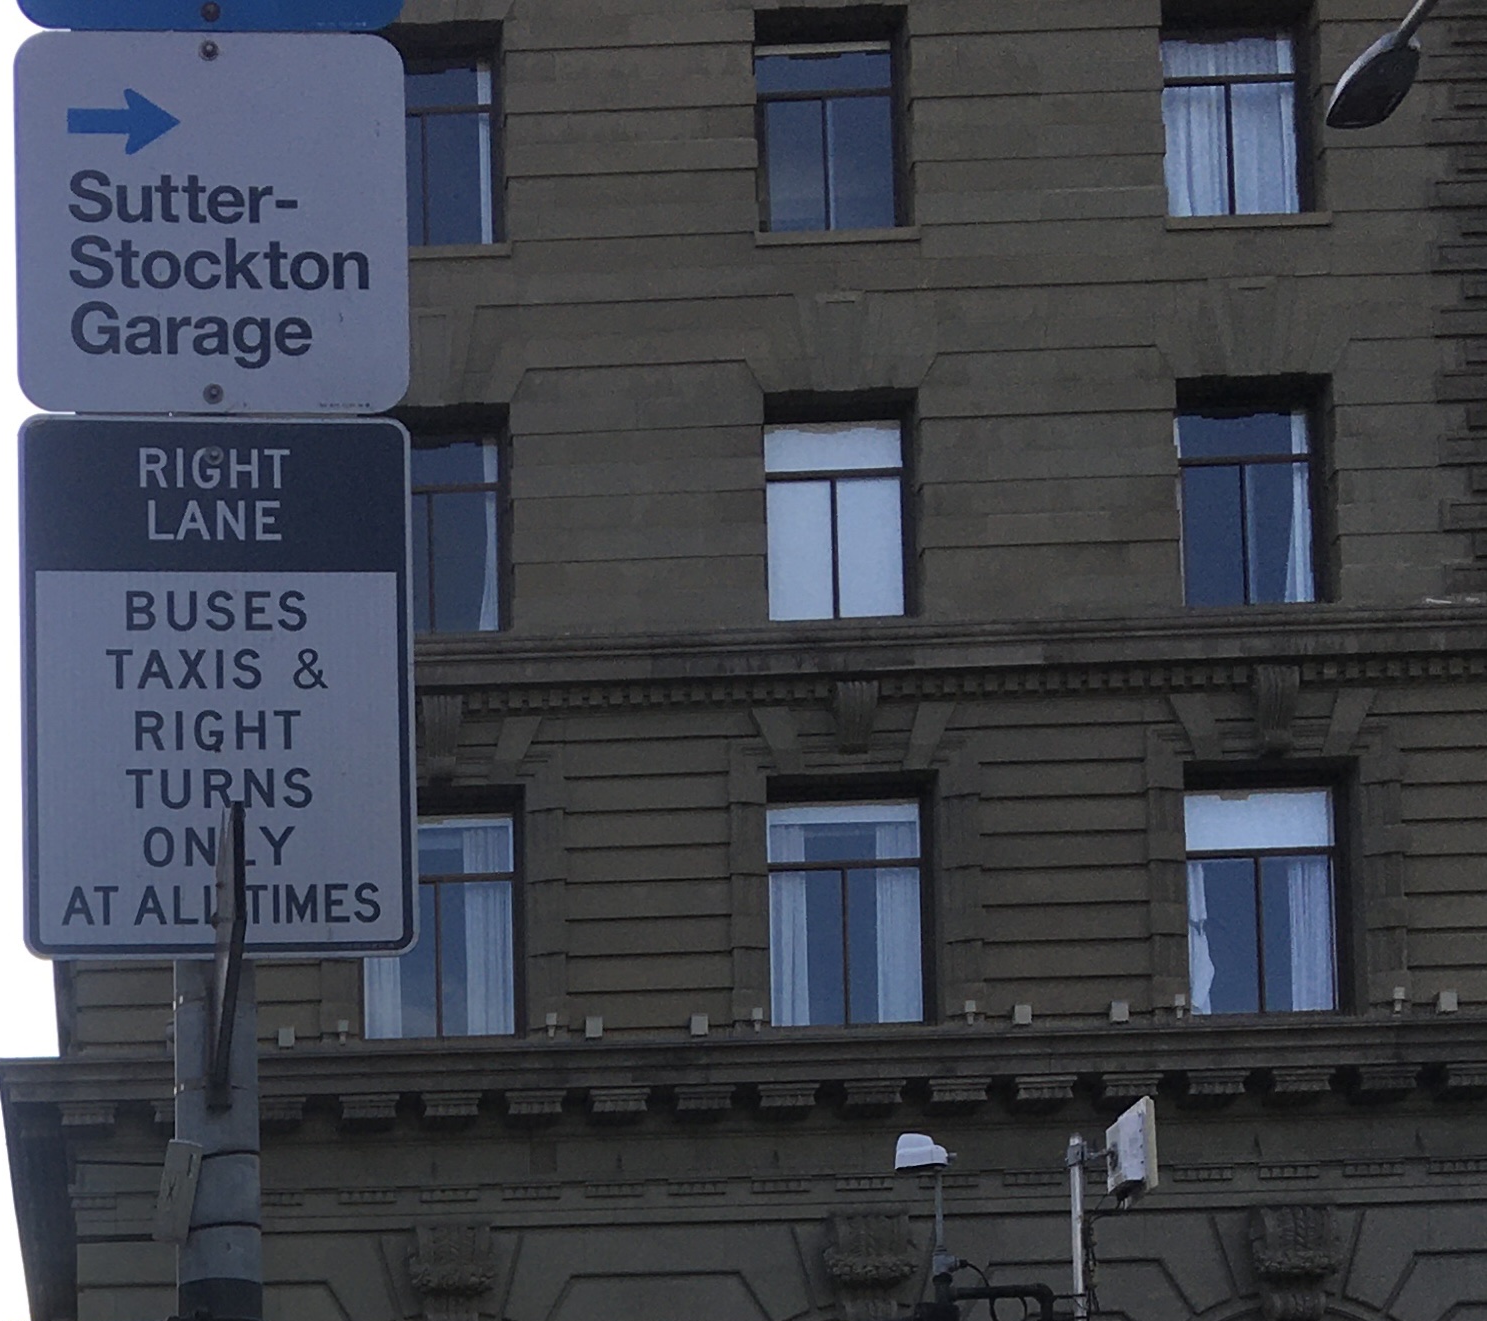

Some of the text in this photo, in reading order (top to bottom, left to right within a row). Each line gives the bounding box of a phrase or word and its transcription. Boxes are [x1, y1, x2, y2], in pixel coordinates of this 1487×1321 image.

[68, 169, 298, 224] Sutter-
[69, 235, 370, 290] Stockton
[70, 301, 313, 369] Garage
[139, 447, 291, 489] RIGHT
[147, 499, 283, 541] LANE
[125, 590, 308, 632] BUSES
[106, 647, 328, 690] TAXIS &
[134, 710, 301, 752] RIGHT
[126, 768, 314, 809] TURNS
[61, 885, 118, 927] AT
[245, 882, 382, 925] TIMES
